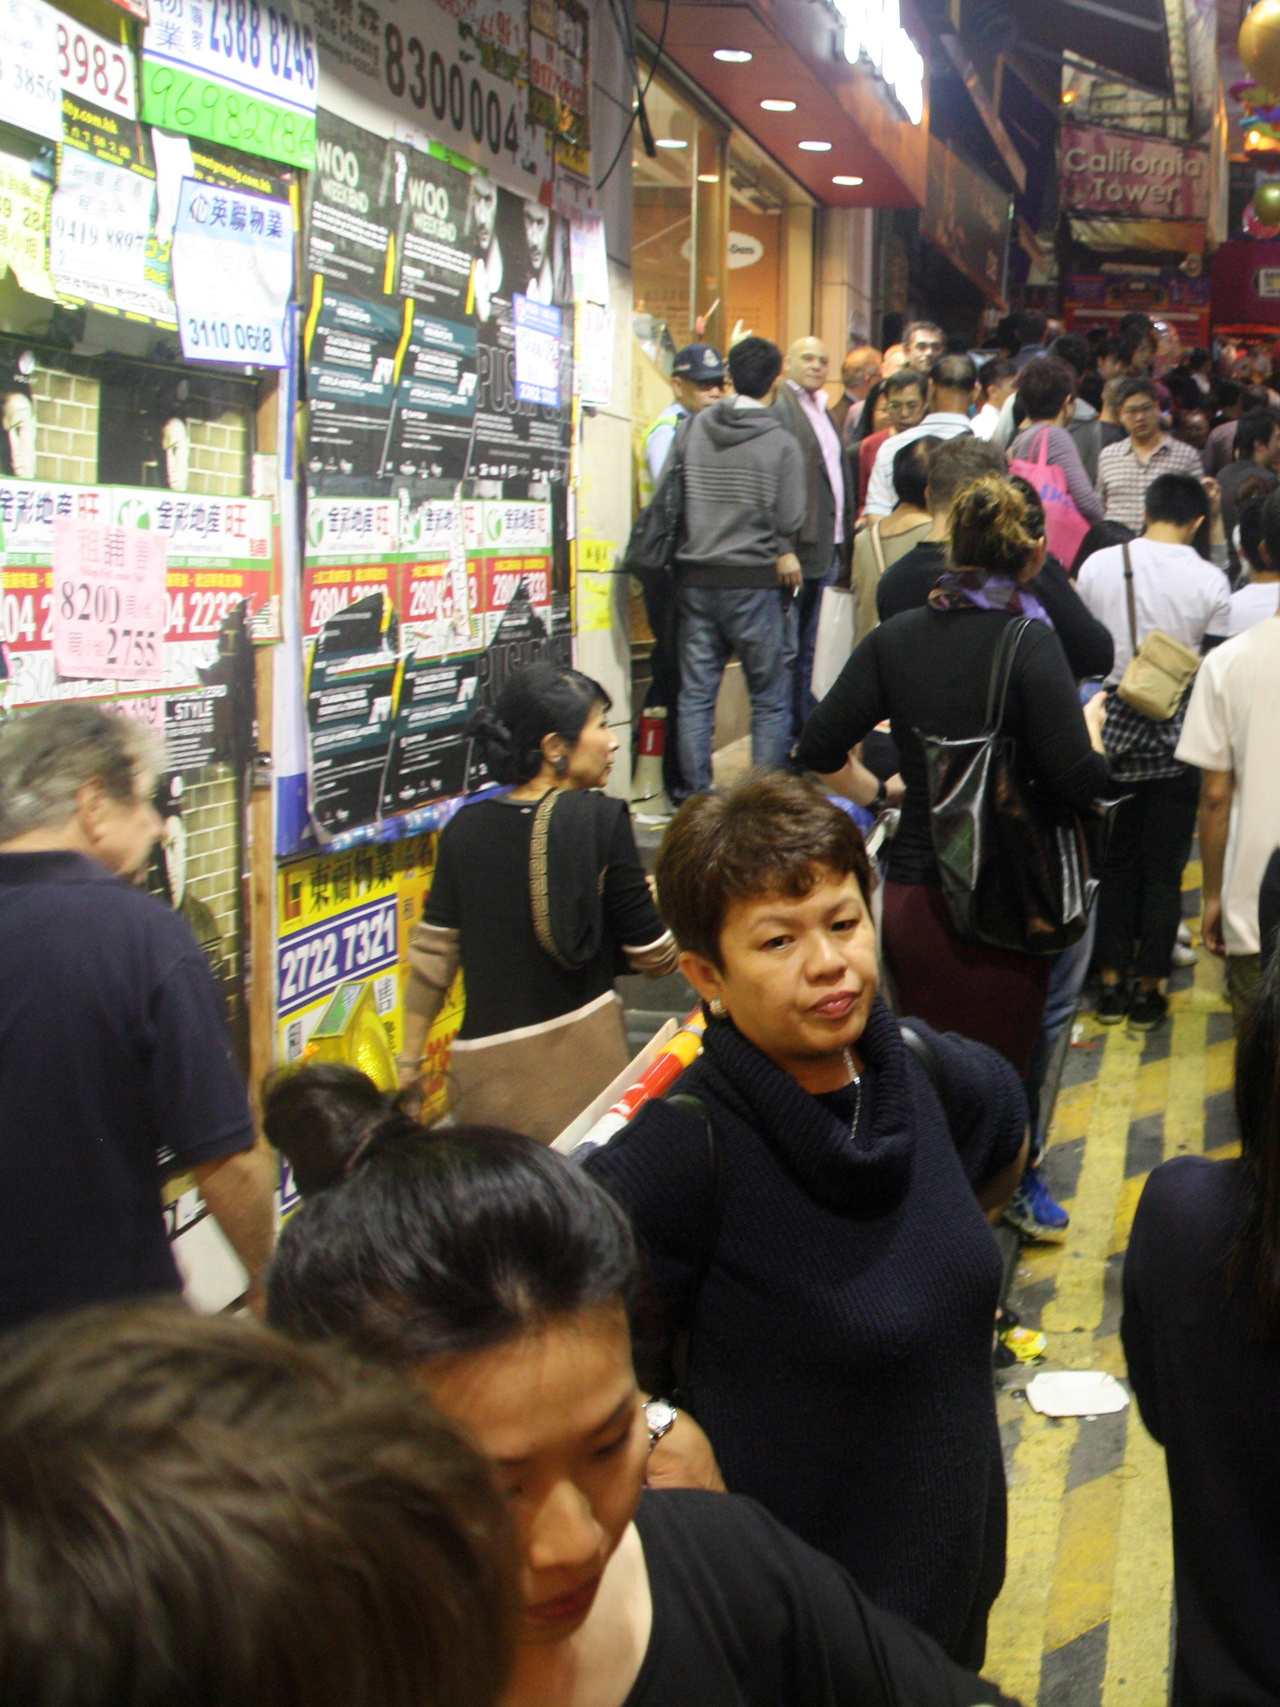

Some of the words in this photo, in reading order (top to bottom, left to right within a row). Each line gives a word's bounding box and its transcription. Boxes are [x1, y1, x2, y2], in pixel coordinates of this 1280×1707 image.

[1064, 147, 1203, 179] California
[408, 178, 449, 219] WOO
[1091, 177, 1179, 204] Tower
[280, 931, 339, 1001] 2722
[342, 908, 395, 972] 7321
